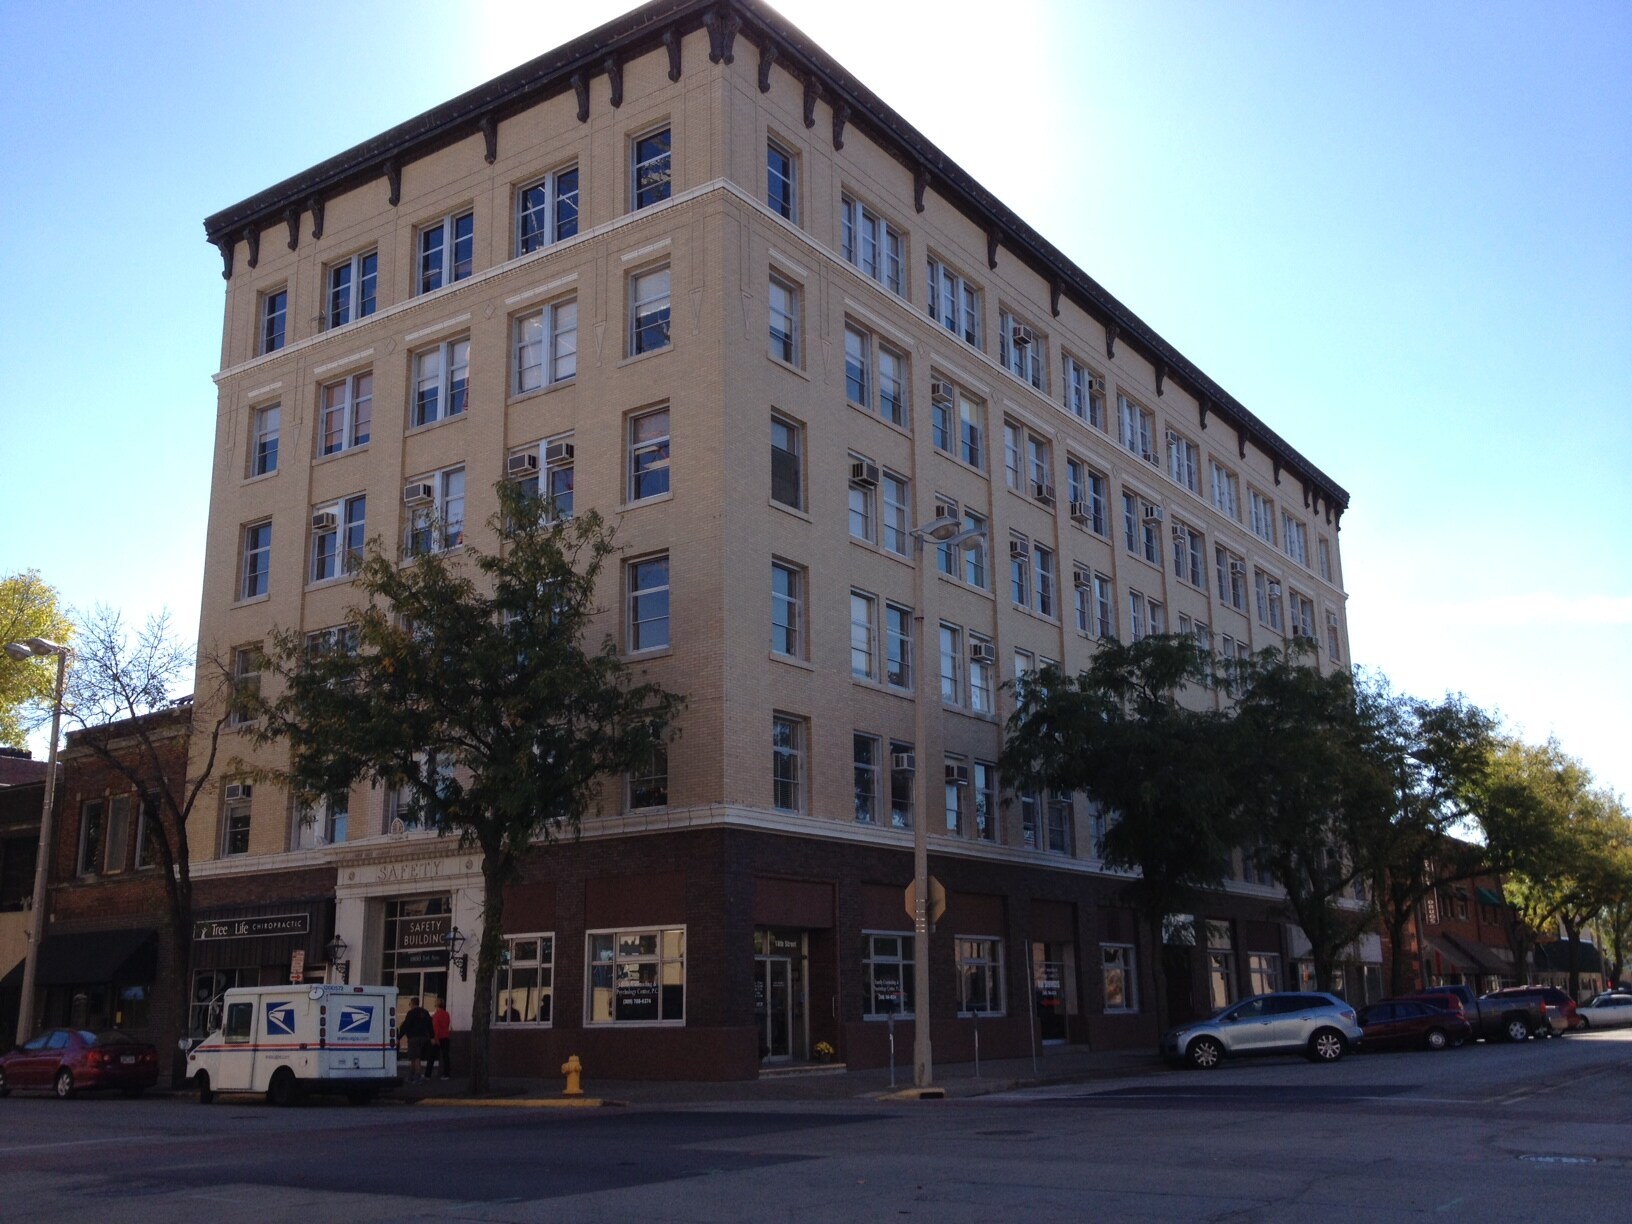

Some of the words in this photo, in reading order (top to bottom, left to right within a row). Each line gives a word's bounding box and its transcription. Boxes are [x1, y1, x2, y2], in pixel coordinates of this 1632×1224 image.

[378, 861, 442, 881] SAFETY
[212, 923, 228, 936] Tree
[234, 921, 249, 934] Life
[252, 920, 302, 931] CHIROPRACTIC
[410, 921, 442, 933] SAFETY
